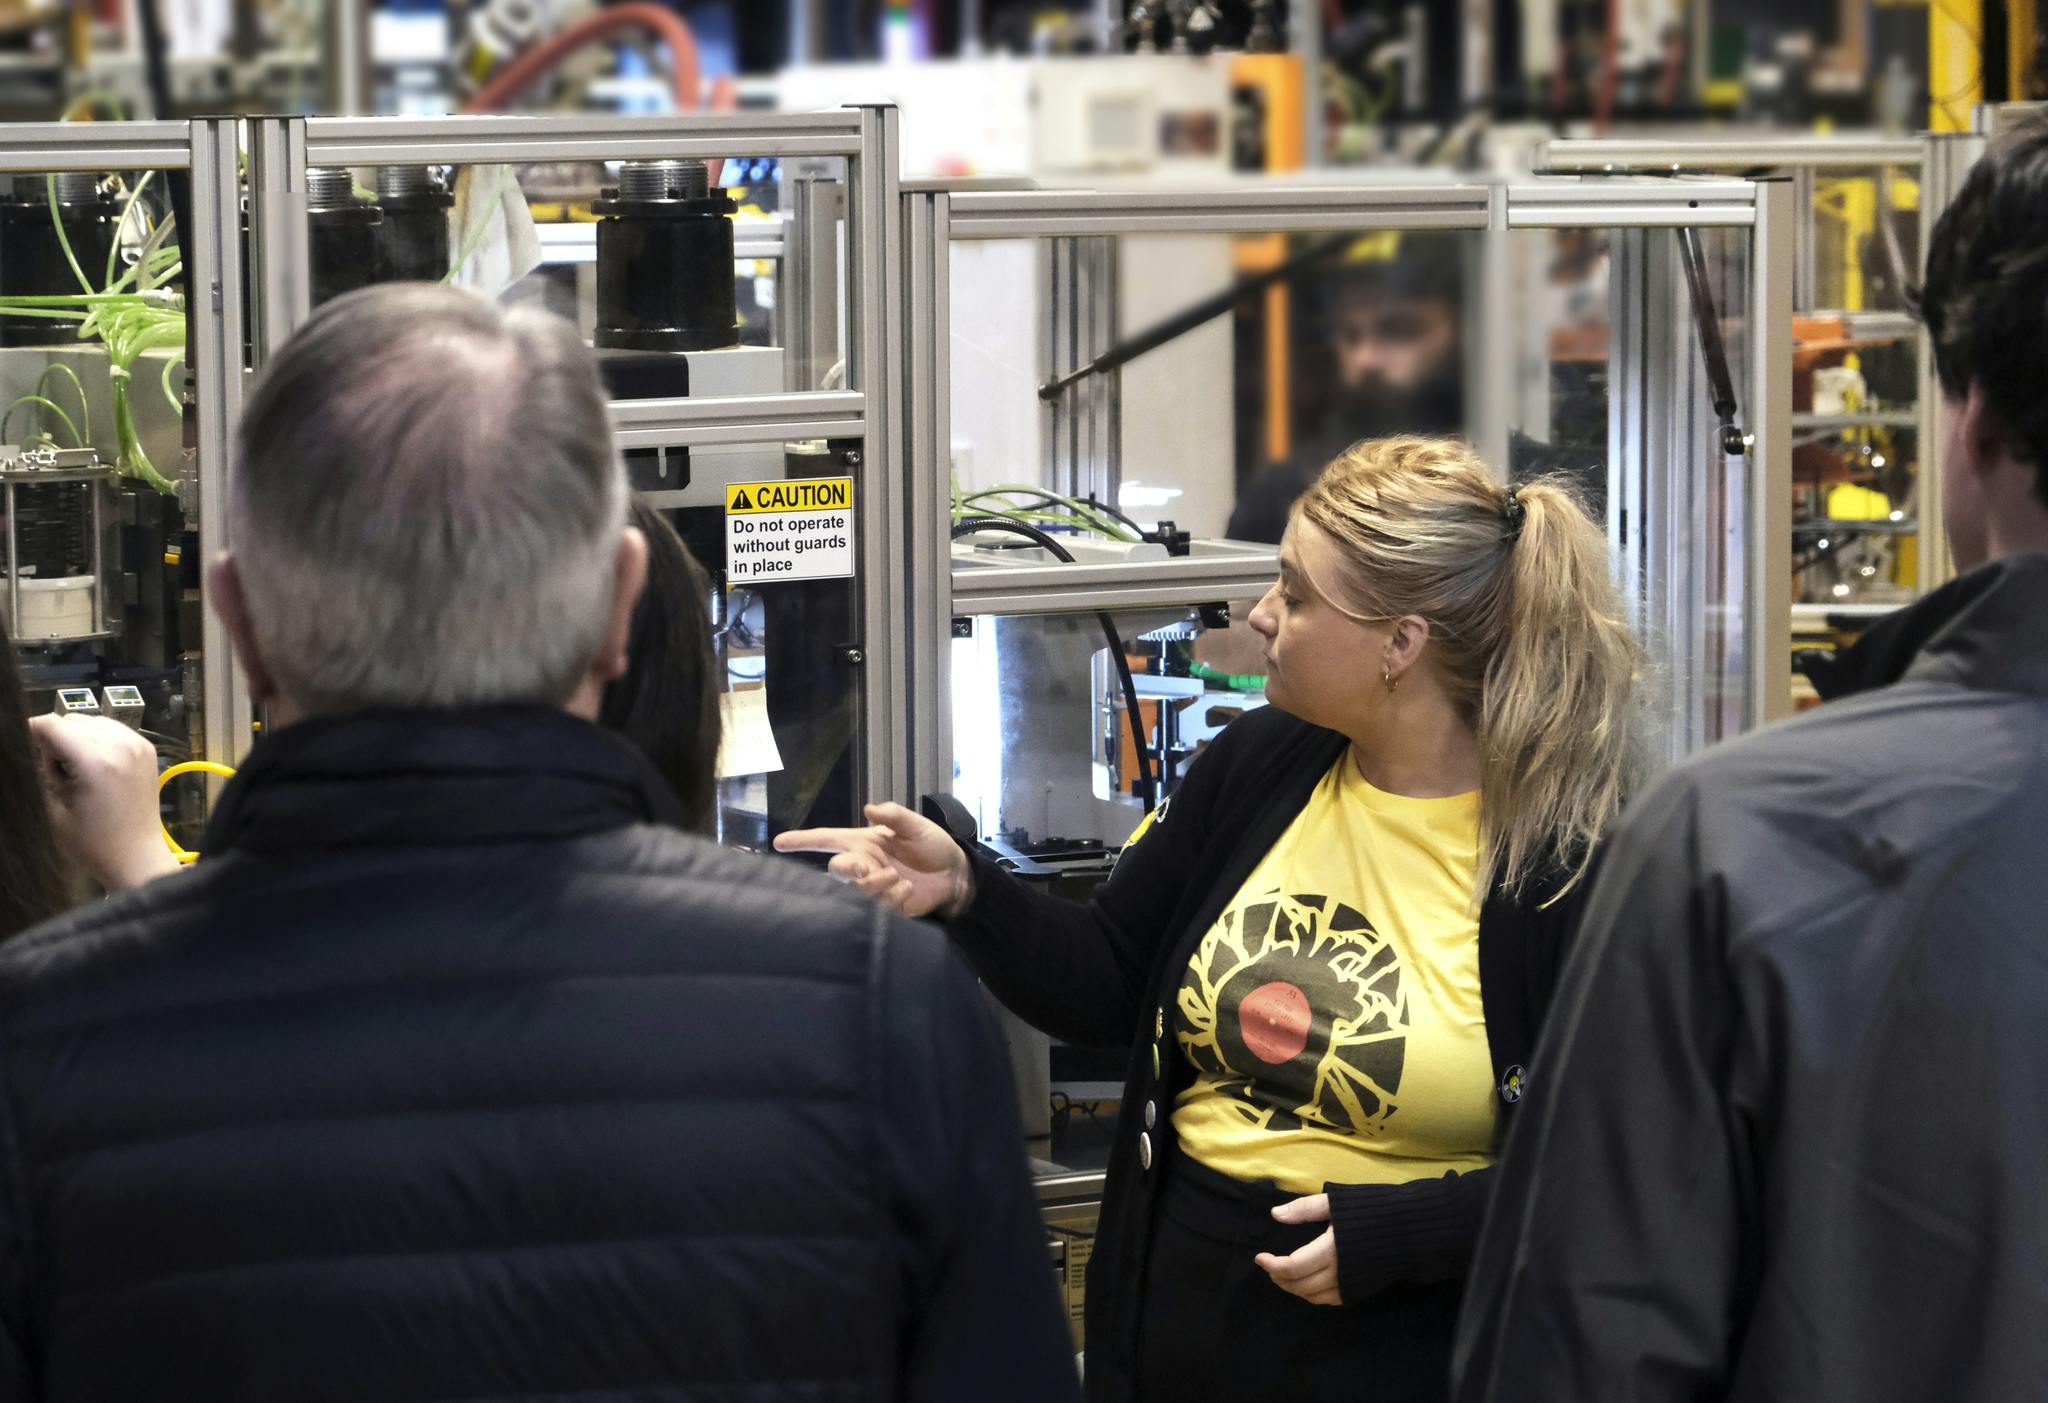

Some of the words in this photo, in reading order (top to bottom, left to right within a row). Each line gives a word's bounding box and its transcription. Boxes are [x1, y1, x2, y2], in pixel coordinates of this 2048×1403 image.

[757, 484, 845, 508] CAUTION
[734, 520, 754, 533] Do
[760, 518, 783, 532] not
[788, 516, 844, 533] operate
[734, 538, 789, 553] without
[795, 535, 846, 553] guards
[734, 560, 747, 573] in
[753, 559, 792, 575] place
